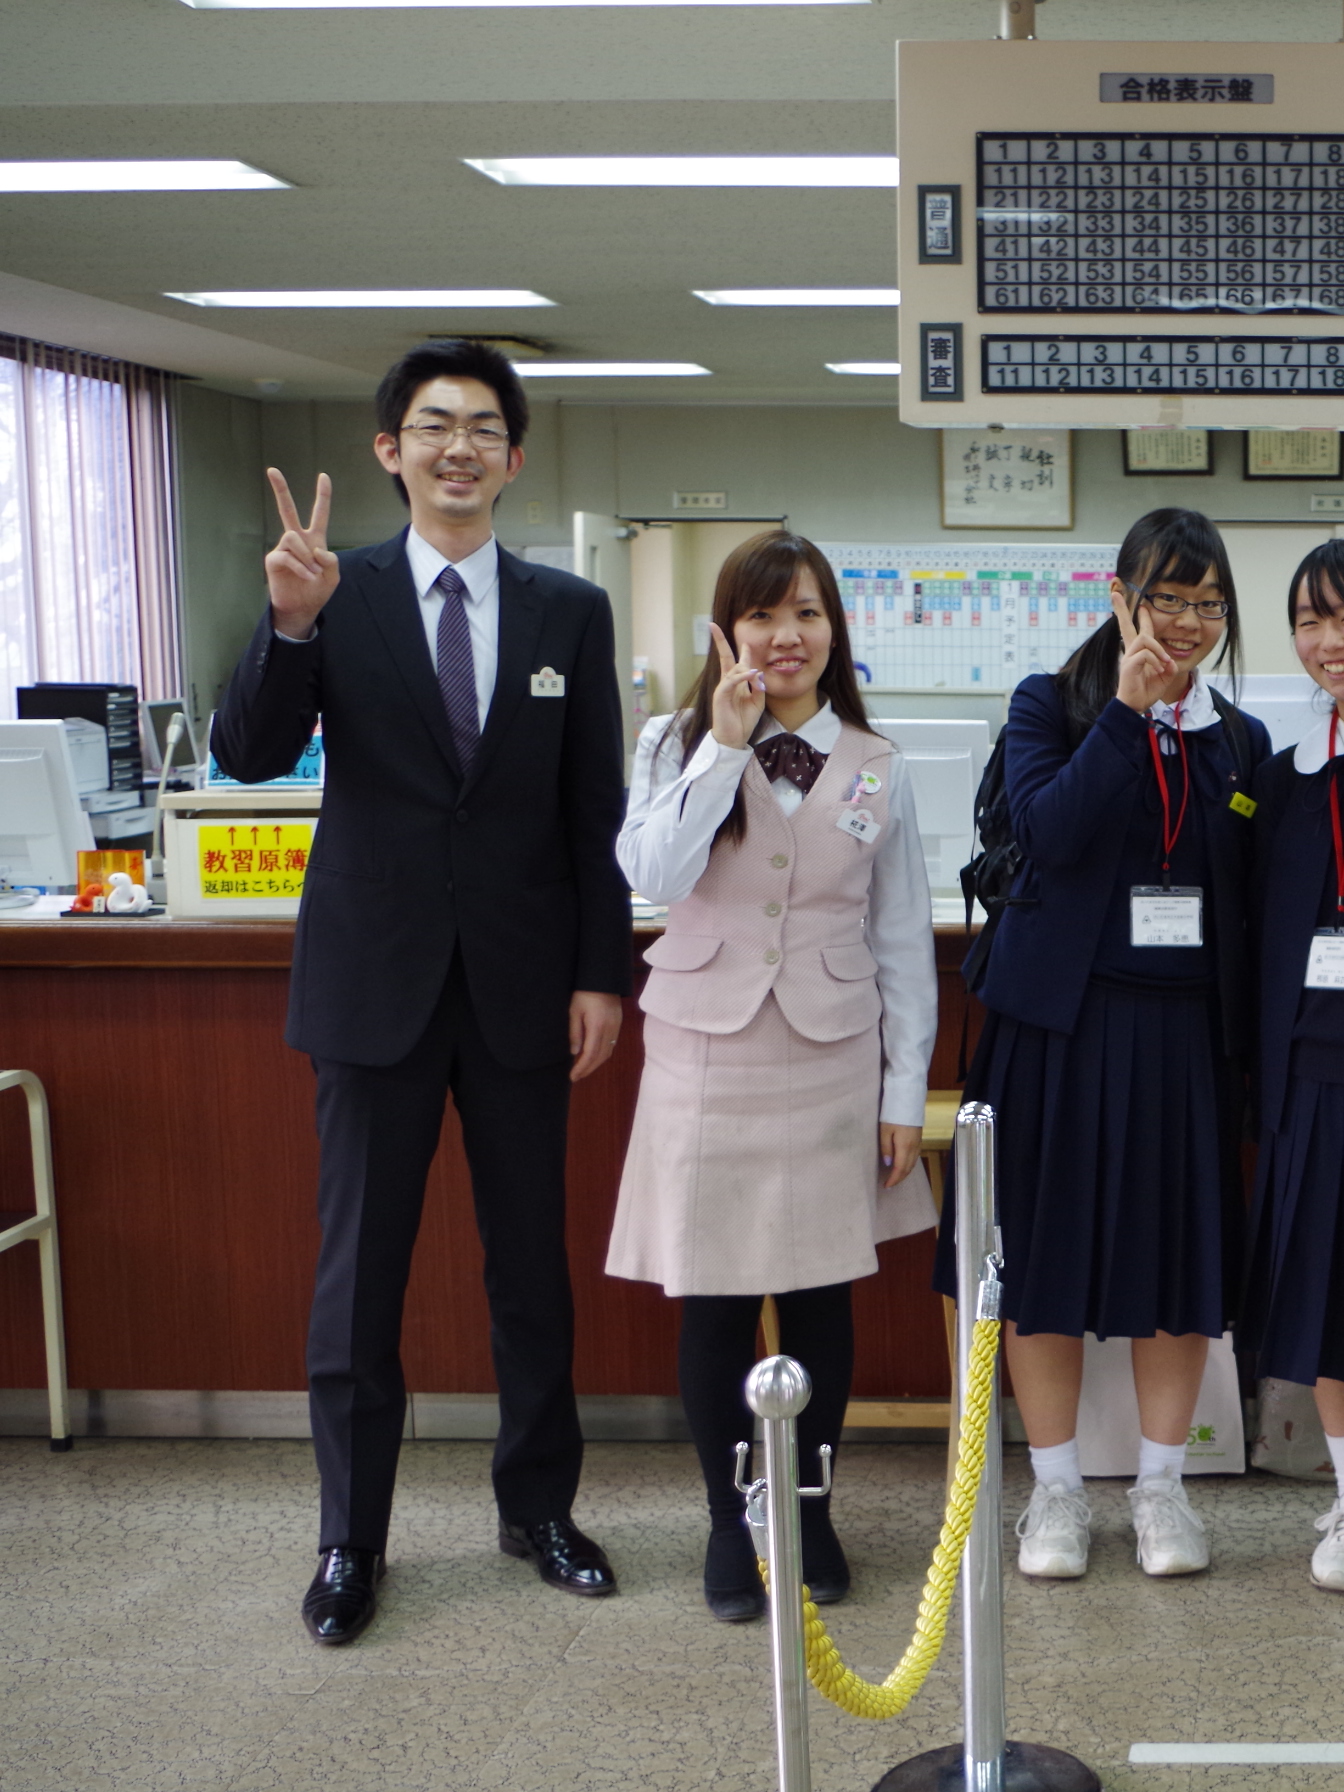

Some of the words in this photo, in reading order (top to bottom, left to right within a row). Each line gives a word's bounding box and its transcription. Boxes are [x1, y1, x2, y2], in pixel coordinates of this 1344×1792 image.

[1119, 78, 1255, 102] 合格表示盤
[998, 142, 1008, 161] 1
[1046, 142, 1060, 161] 2
[1092, 143, 1107, 161] 3
[1139, 143, 1153, 162] 4
[1188, 143, 1202, 162] 5
[1234, 144, 1249, 162] 6
[1280, 144, 1293, 163] 7
[1328, 144, 1342, 163] 8
[994, 166, 1019, 185] 11
[1039, 166, 1069, 185] 12
[1085, 167, 1115, 185] 13
[1133, 167, 1162, 186] 14
[1179, 167, 1208, 186] 15
[1226, 168, 1255, 186] 16
[1273, 168, 1302, 187] 17
[994, 190, 1019, 209] 21
[1038, 191, 1069, 209] 22
[1085, 191, 1115, 209] 23
[1132, 191, 1162, 210] 24
[1179, 192, 1208, 210] 25
[1226, 192, 1255, 210] 26
[1272, 192, 1302, 211] 27
[928, 195, 950, 251] 普通
[1038, 215, 1069, 233] 32
[1085, 215, 1115, 234] 33
[1132, 215, 1162, 234] 34
[1179, 216, 1208, 234] 35
[1226, 216, 1255, 235] 36
[1272, 216, 1302, 235] 37
[994, 238, 1019, 257] 41
[1038, 238, 1069, 257] 42
[1085, 239, 1115, 257] 43
[1132, 239, 1162, 258] 44
[1179, 239, 1208, 258] 45
[1226, 240, 1255, 258] 46
[1272, 240, 1302, 259] 47
[994, 262, 1019, 281] 51
[1038, 262, 1069, 281] 52
[1085, 263, 1115, 281] 53
[1132, 263, 1162, 282] 54
[1179, 263, 1208, 282] 55
[1226, 264, 1255, 282] 56
[1272, 264, 1302, 283] 57
[994, 286, 1019, 305] 61
[1038, 287, 1069, 305] 62
[1085, 287, 1115, 306] 63
[1132, 287, 1162, 306] 64
[1226, 288, 1255, 307] 66
[1272, 288, 1302, 307] 67
[930, 337, 952, 389] 審査
[1002, 344, 1012, 363] 1
[1047, 344, 1061, 363] 2
[1094, 344, 1108, 363] 3
[1139, 345, 1154, 364] 4
[1185, 345, 1200, 364] 5
[1231, 345, 1246, 364] 6
[1280, 346, 1293, 365] 7
[1326, 346, 1341, 365] 8
[996, 367, 1019, 386] 11
[1042, 367, 1071, 386] 12
[1086, 368, 1116, 387] 13
[1133, 368, 1162, 387] 14
[1179, 368, 1208, 387] 15
[1225, 369, 1255, 388] 16
[1272, 369, 1300, 388] 17
[203, 849, 308, 874] 教習原簿
